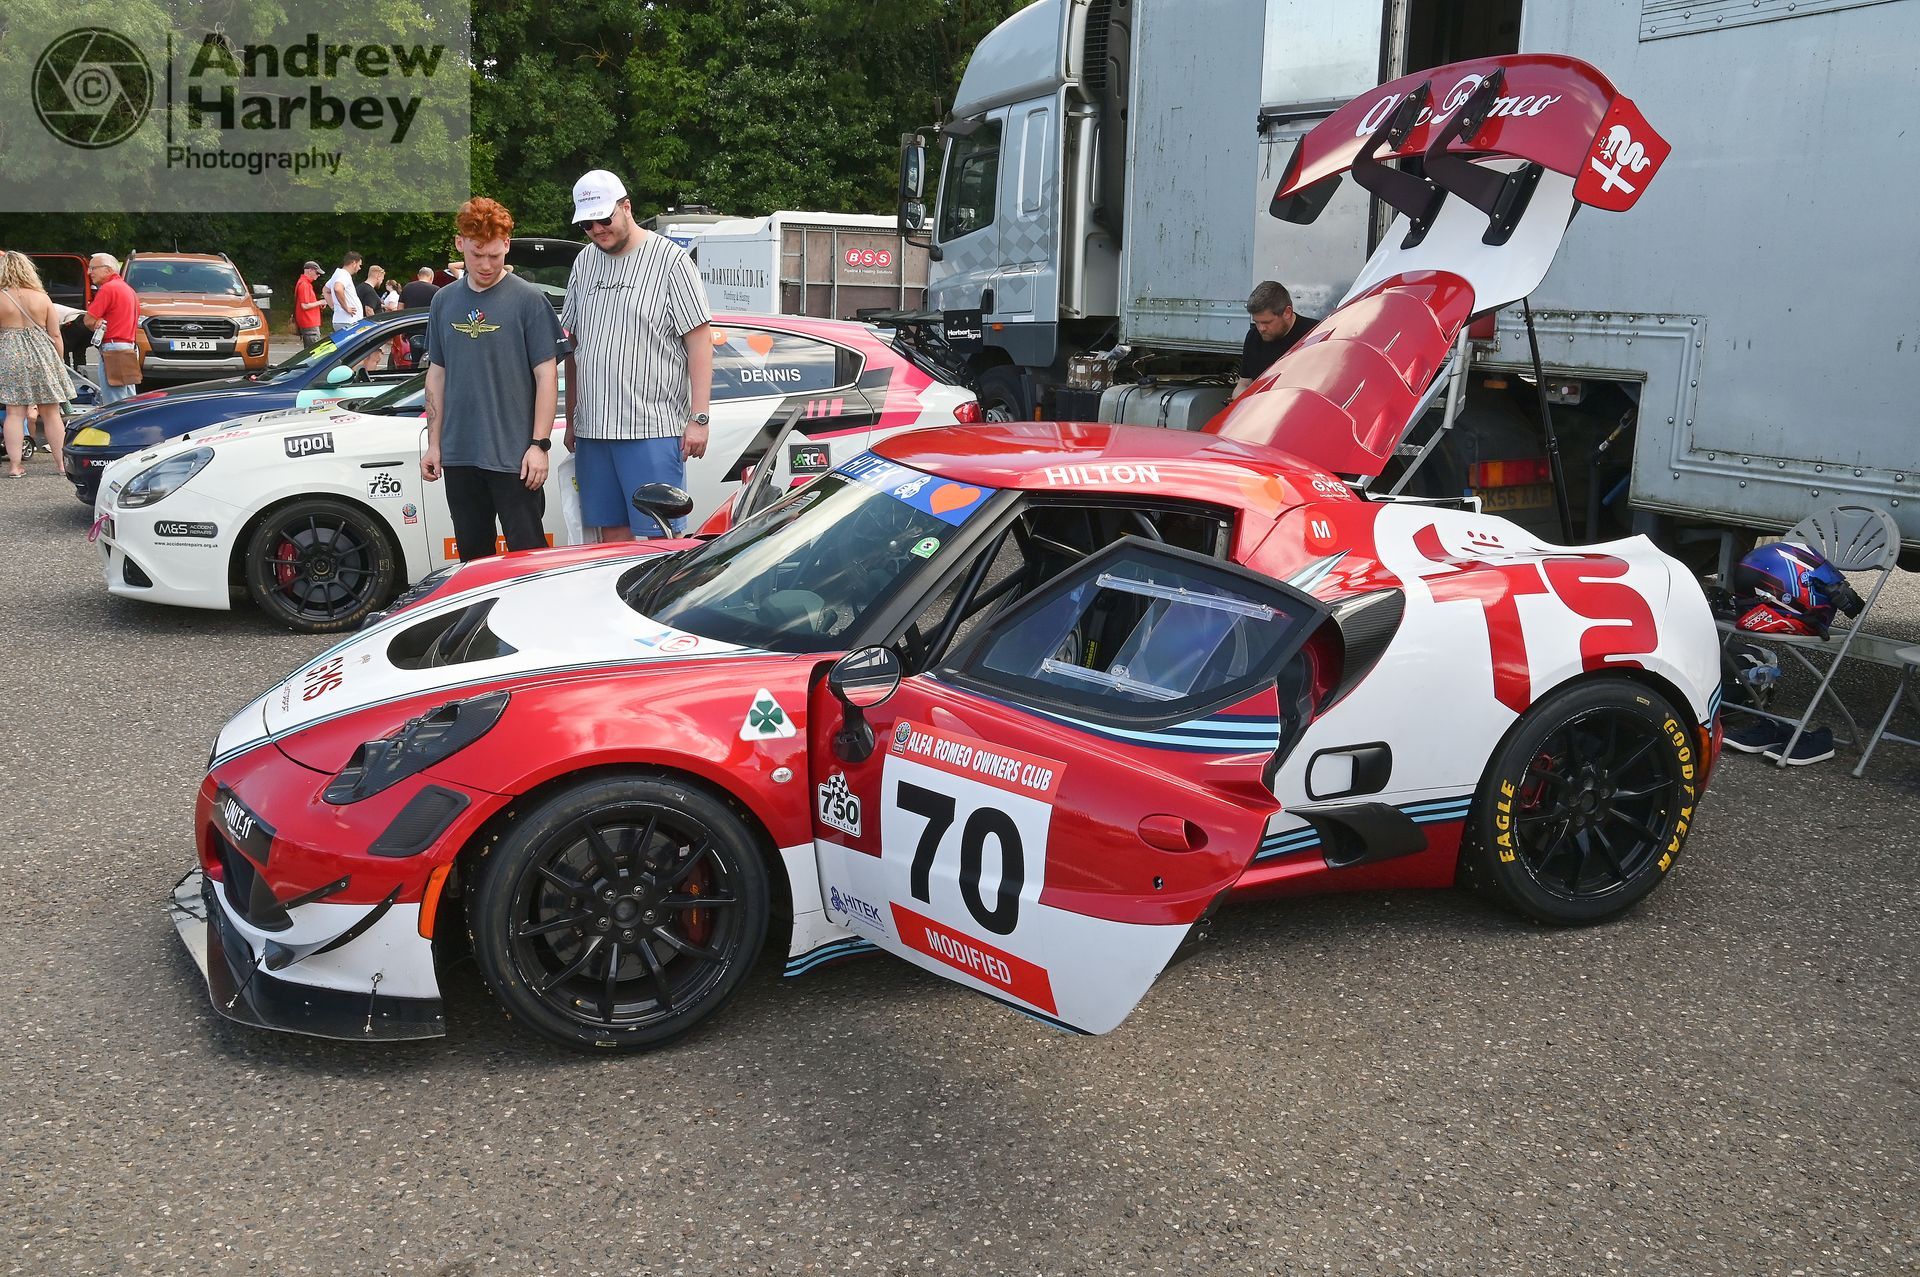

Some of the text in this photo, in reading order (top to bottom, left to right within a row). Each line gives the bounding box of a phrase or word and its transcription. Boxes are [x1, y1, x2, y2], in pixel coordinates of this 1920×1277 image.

[849, 252, 888, 264] BSS
[180, 341, 197, 350] PAR
[712, 331, 721, 341] P
[740, 368, 802, 383] DENNIS
[287, 433, 332, 456] upol
[793, 453, 828, 466] ARCA
[840, 455, 905, 487] HITEK
[1043, 464, 1161, 486] HILTON
[368, 480, 402, 494] 750
[1311, 479, 1347, 493] GMS
[158, 523, 188, 535] M&S
[1310, 520, 1332, 539] M
[907, 731, 933, 755] ALFA
[933, 738, 973, 768] ROMEO
[972, 749, 1022, 782] OWNERS
[1021, 764, 1053, 791] CLUB
[821, 789, 859, 825] 750
[822, 814, 858, 833] MOTOR CLUB
[1495, 778, 1516, 864] EAGLE
[896, 779, 1025, 936] 70
[842, 892, 882, 923] HITEK
[924, 926, 1013, 986] MODIFIED
